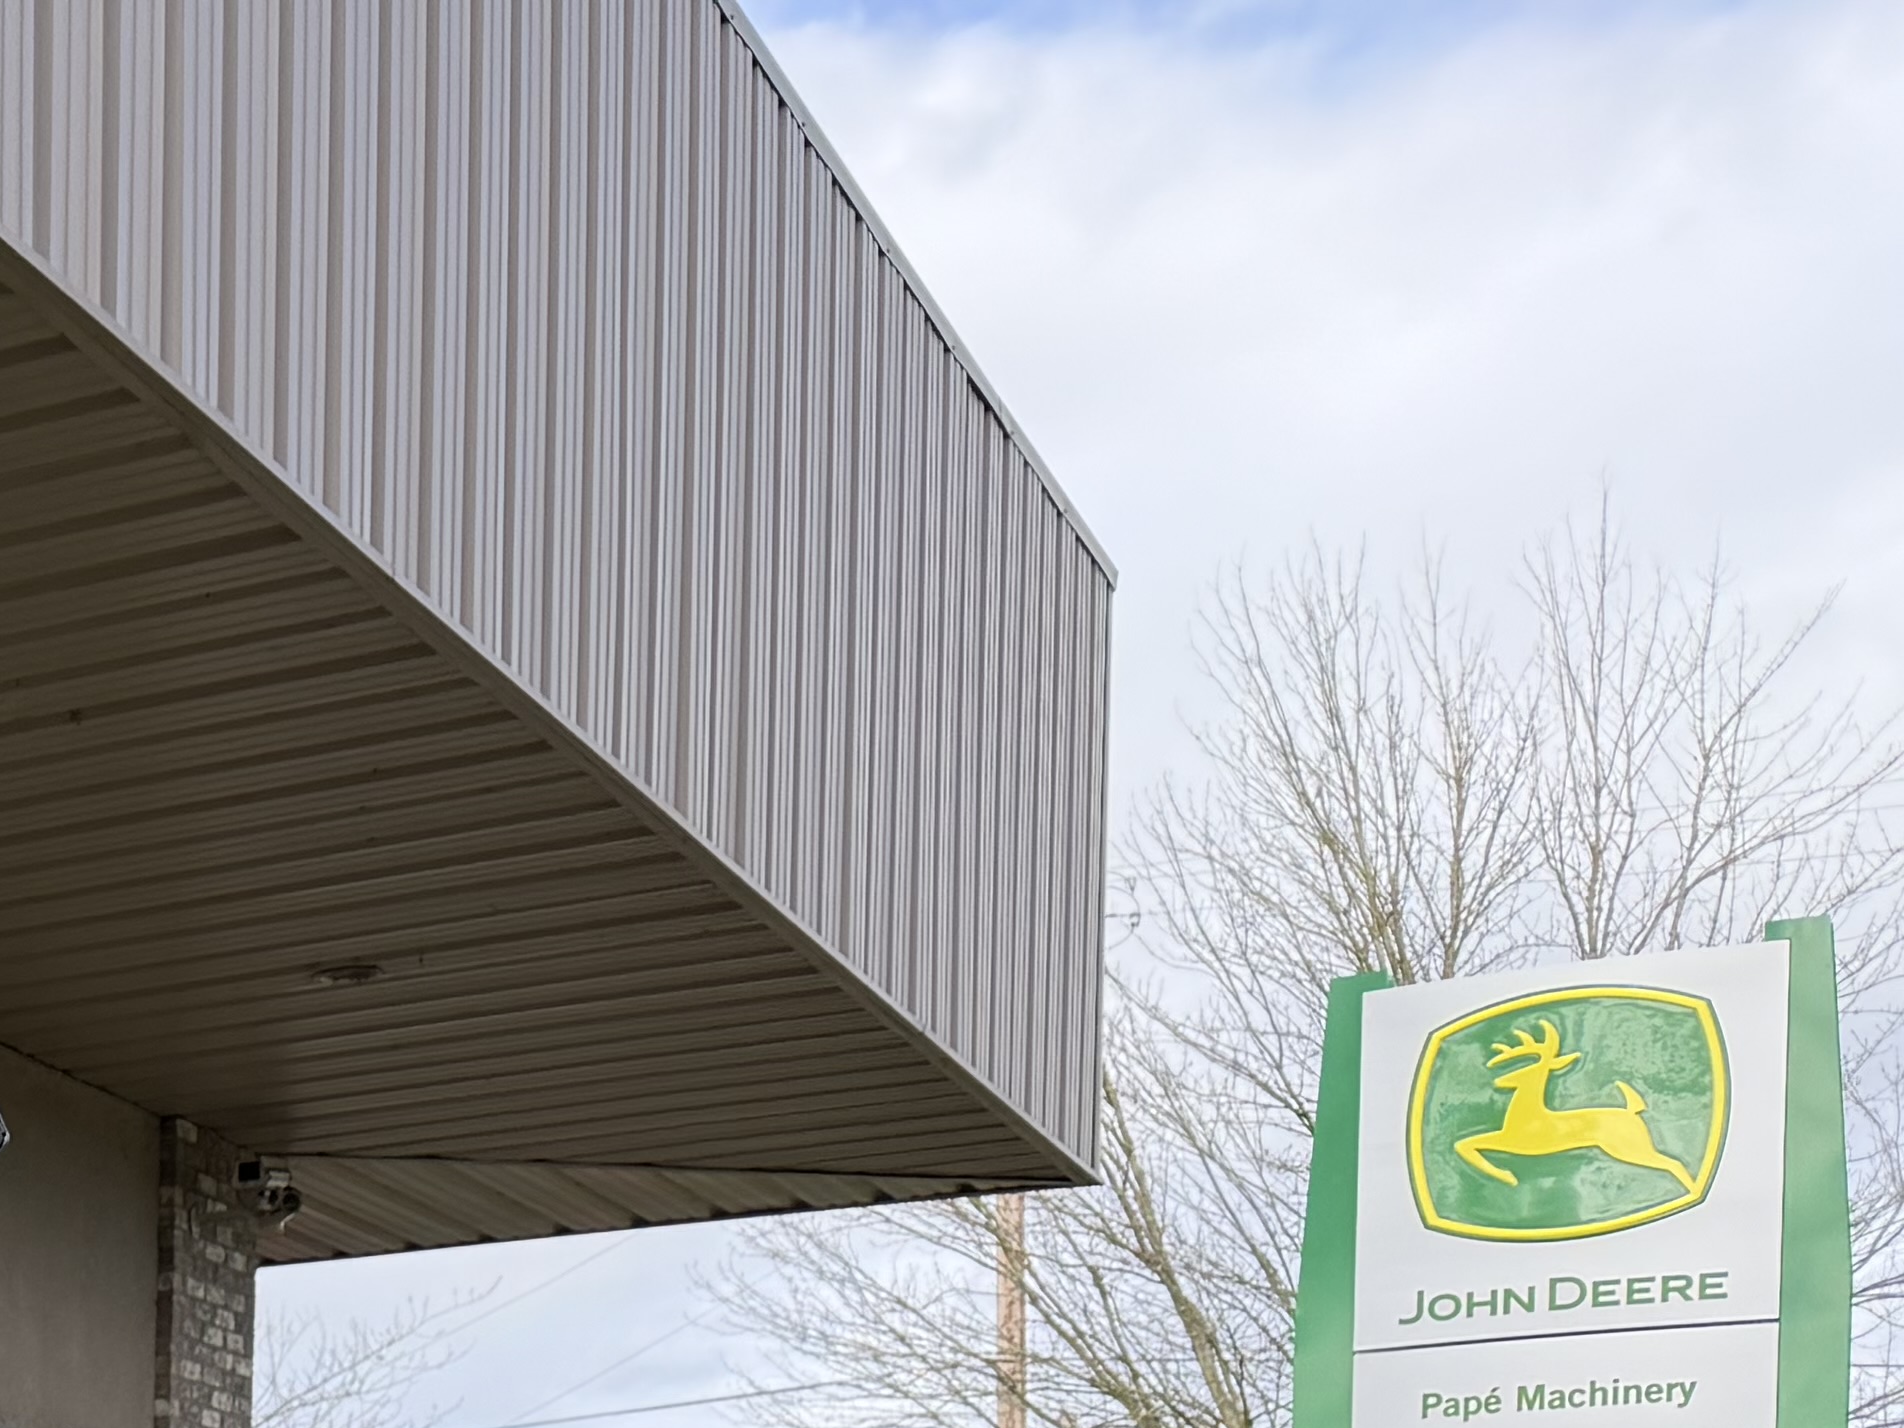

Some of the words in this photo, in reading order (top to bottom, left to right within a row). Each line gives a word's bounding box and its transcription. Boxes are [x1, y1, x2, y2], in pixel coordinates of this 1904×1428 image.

[1397, 1284, 1536, 1325] JOHN
[1548, 1271, 1730, 1312] DEERE
[1421, 1386, 1503, 1422] Papé
[1516, 1378, 1698, 1412] Machinery
